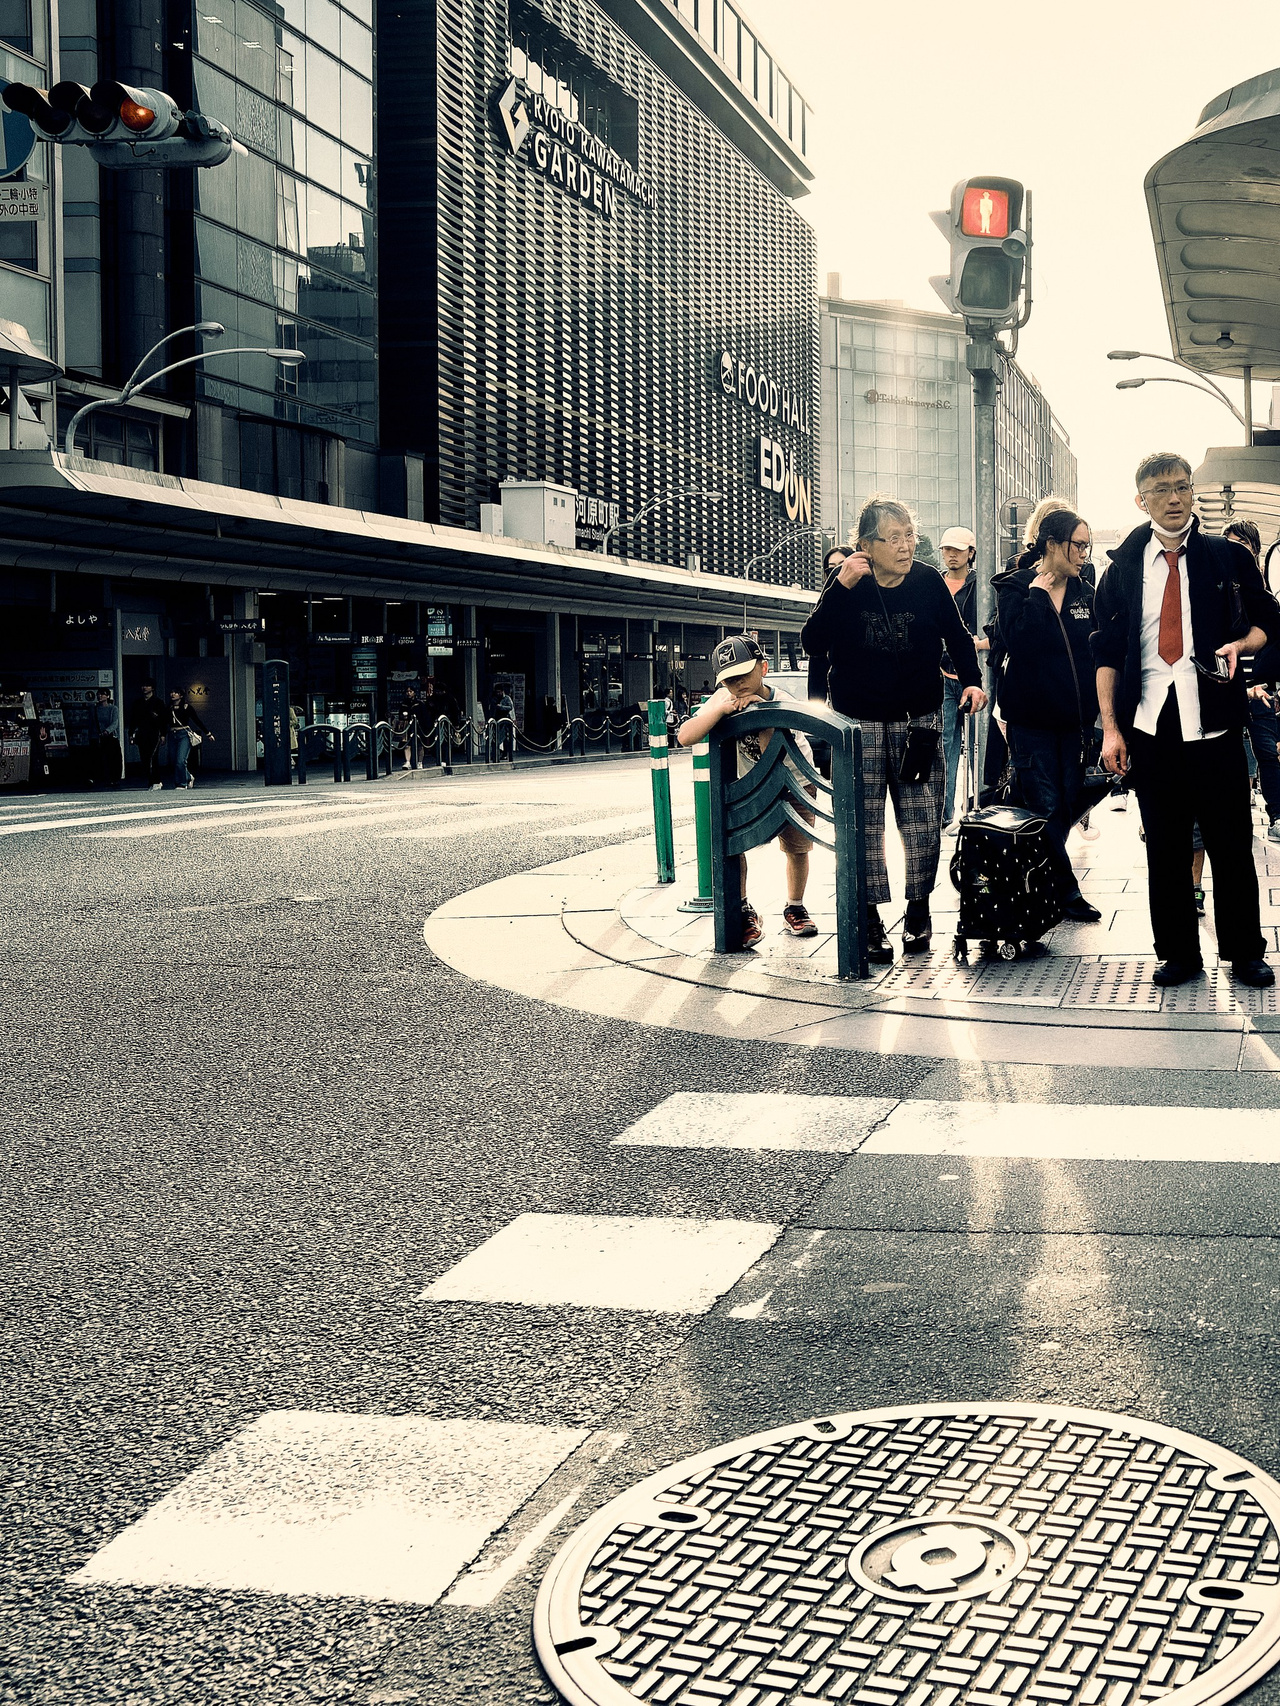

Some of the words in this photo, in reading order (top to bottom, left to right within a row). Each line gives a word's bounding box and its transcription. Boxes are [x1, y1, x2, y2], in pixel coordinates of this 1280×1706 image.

[534, 94, 575, 146] KYOTO
[581, 134, 659, 210] KAWARAMACHI
[534, 131, 616, 218] GARDEN
[738, 360, 779, 417] FOOD
[782, 388, 811, 436] HALL
[880, 393, 936, 410] Takashimaya
[760, 436, 812, 525] EDION
[65, 614, 98, 625] よしや
[432, 637, 453, 646] Sigma
